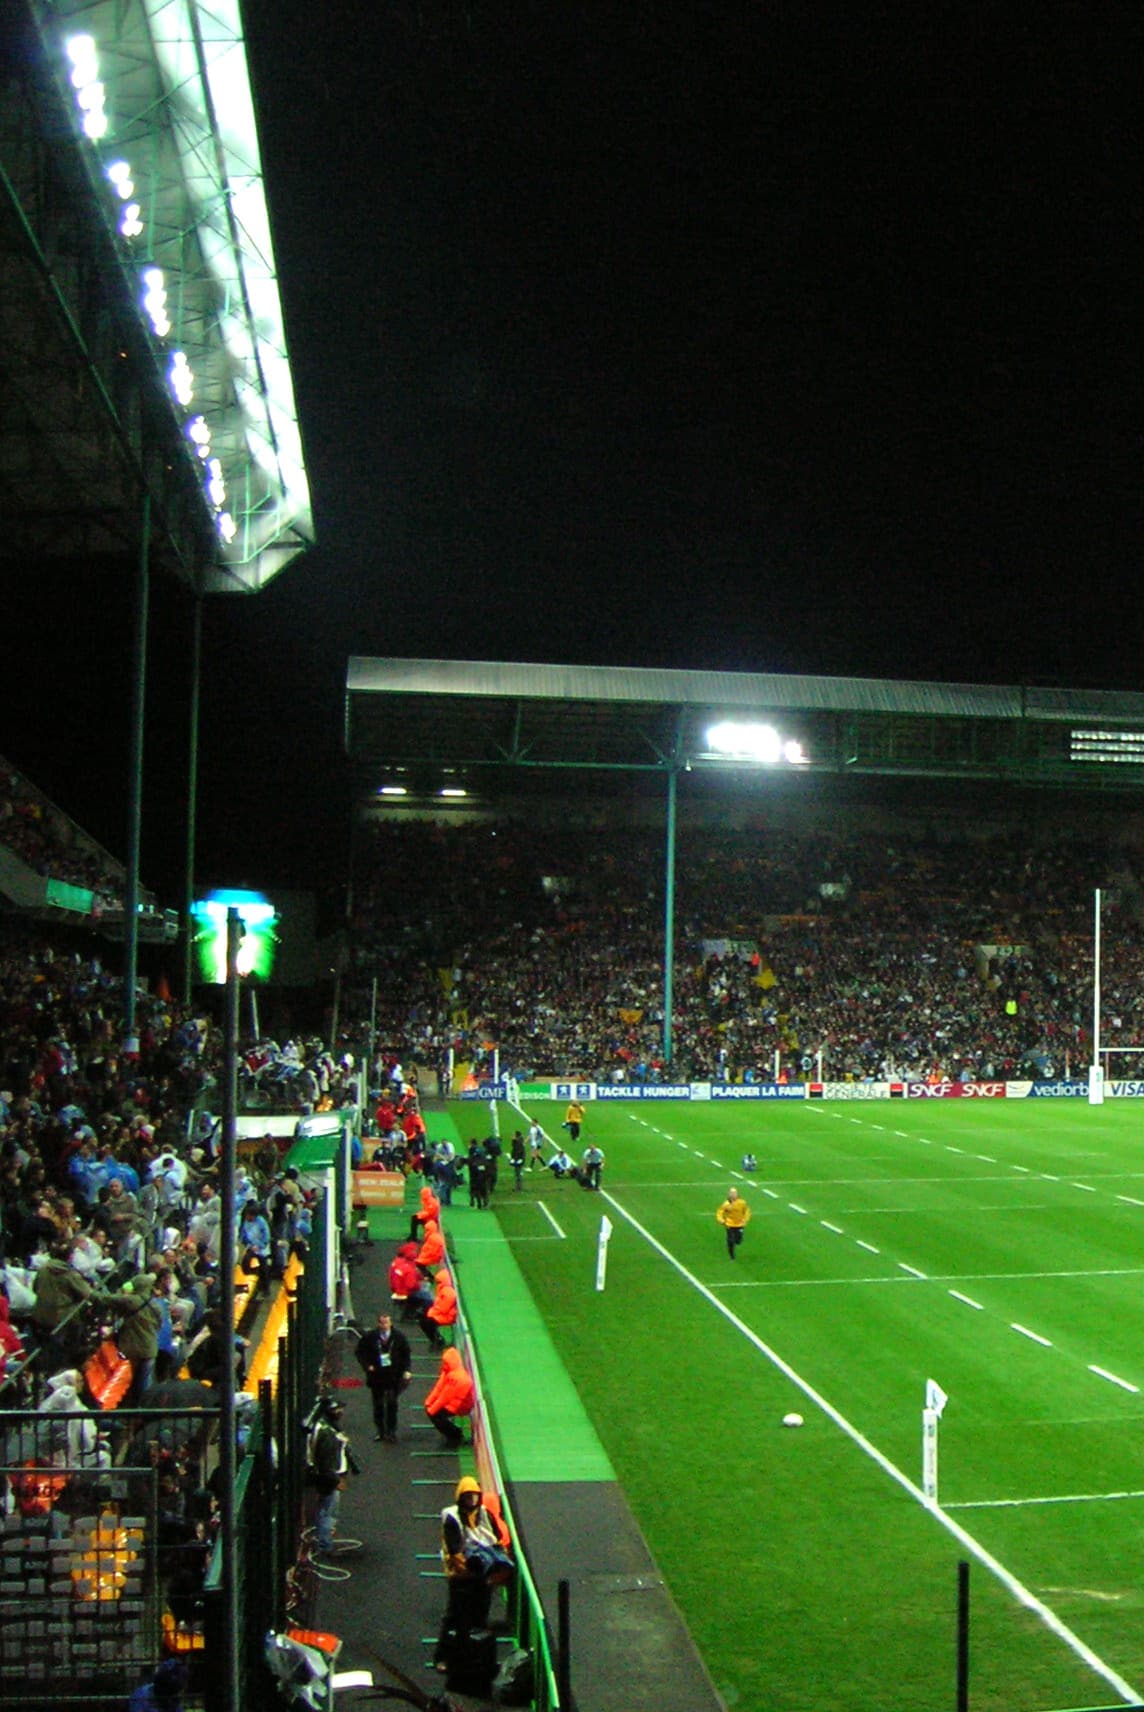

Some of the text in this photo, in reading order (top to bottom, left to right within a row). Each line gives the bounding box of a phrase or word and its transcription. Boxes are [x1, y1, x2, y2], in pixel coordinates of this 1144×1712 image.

[597, 1086, 690, 1098] TACKLE HUNGER
[712, 1086, 759, 1097] PLAQUER
[762, 1086, 776, 1097] LA
[910, 1083, 953, 1097] SNCF
[961, 1083, 1005, 1097] SNCF
[1034, 1081, 1089, 1097] vediorb
